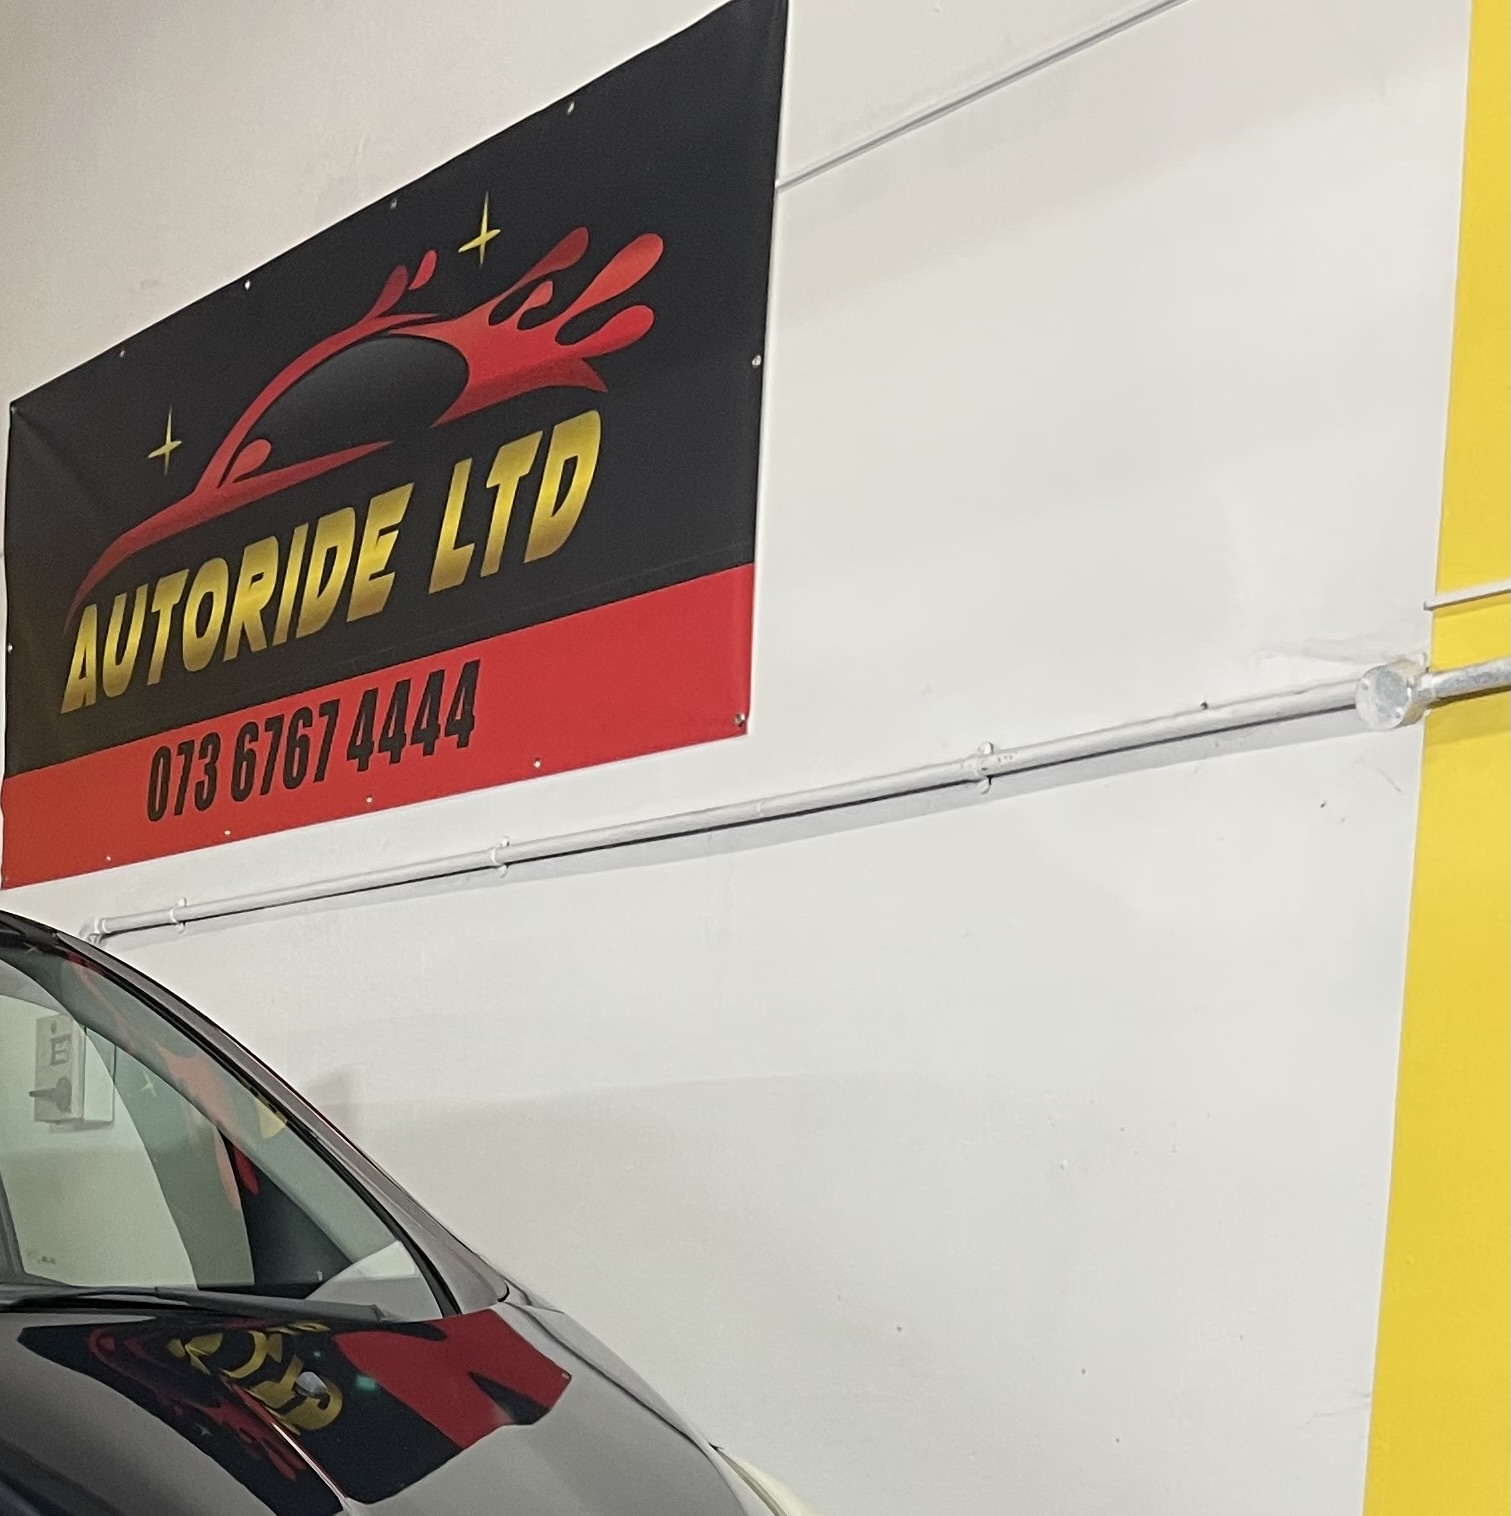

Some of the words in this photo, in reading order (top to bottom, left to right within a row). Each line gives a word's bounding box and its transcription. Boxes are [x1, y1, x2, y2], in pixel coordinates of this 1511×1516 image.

[61, 483, 414, 714] AUTORIDE
[430, 410, 602, 594] LTD
[148, 732, 219, 822] 073
[230, 699, 338, 802] 6767
[347, 660, 479, 772] 4444
